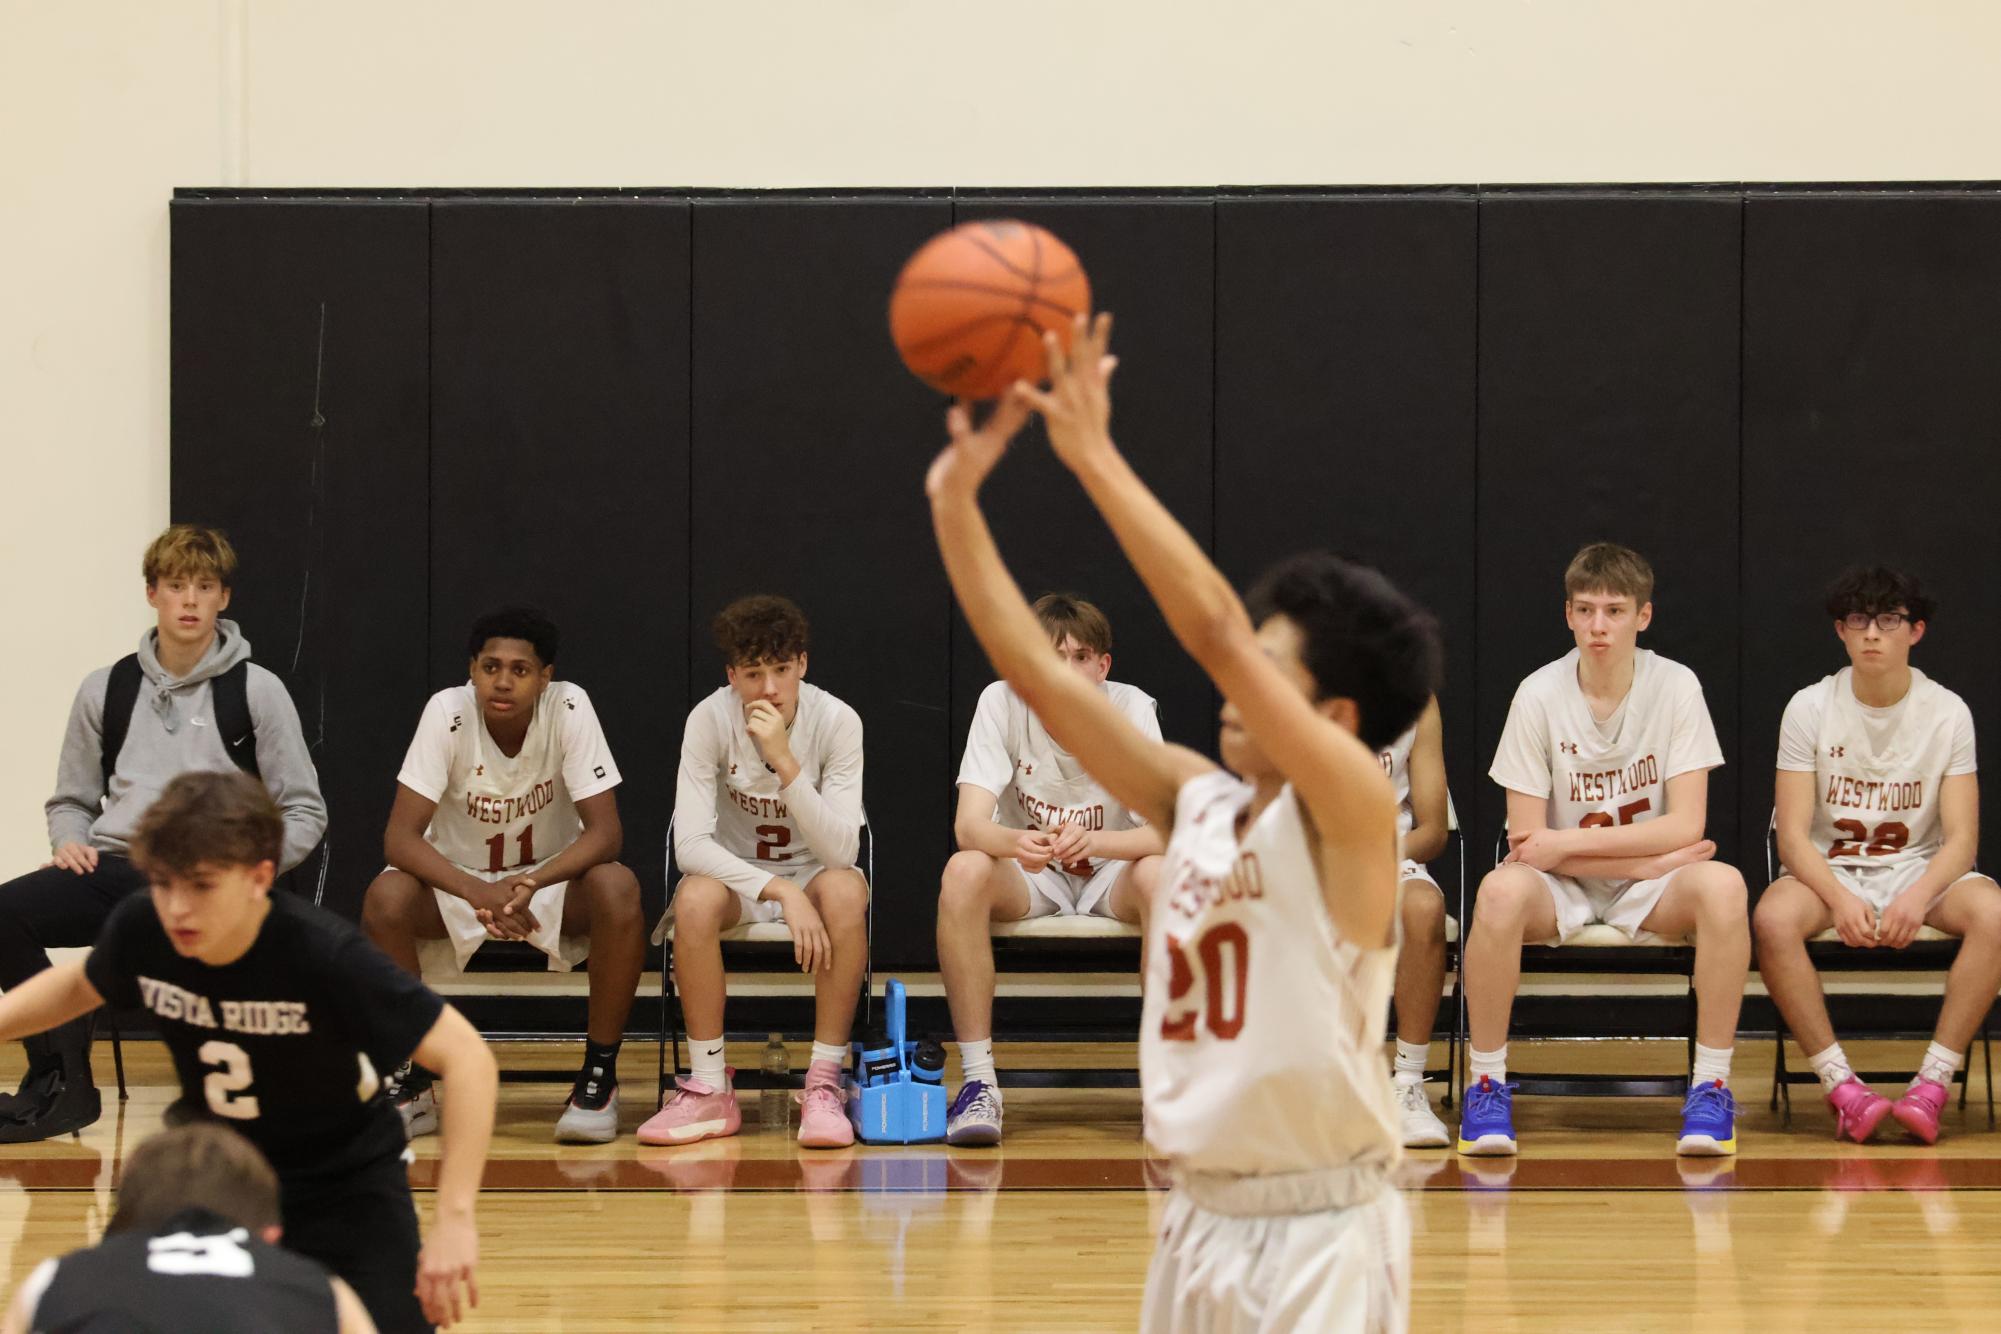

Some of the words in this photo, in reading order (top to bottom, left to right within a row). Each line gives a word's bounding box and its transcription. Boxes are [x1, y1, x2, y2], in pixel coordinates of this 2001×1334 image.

[1569, 753, 1658, 801] WESTWOOD
[1825, 774, 1922, 811] WESTWOOD
[466, 779, 554, 823] WESTWOOD
[726, 783, 787, 819] WESTW
[485, 824, 537, 873] 11
[756, 824, 792, 862] 2
[137, 975, 219, 1028] VISTA
[219, 1001, 311, 1035] RIDGE
[198, 1040, 261, 1119] 2
